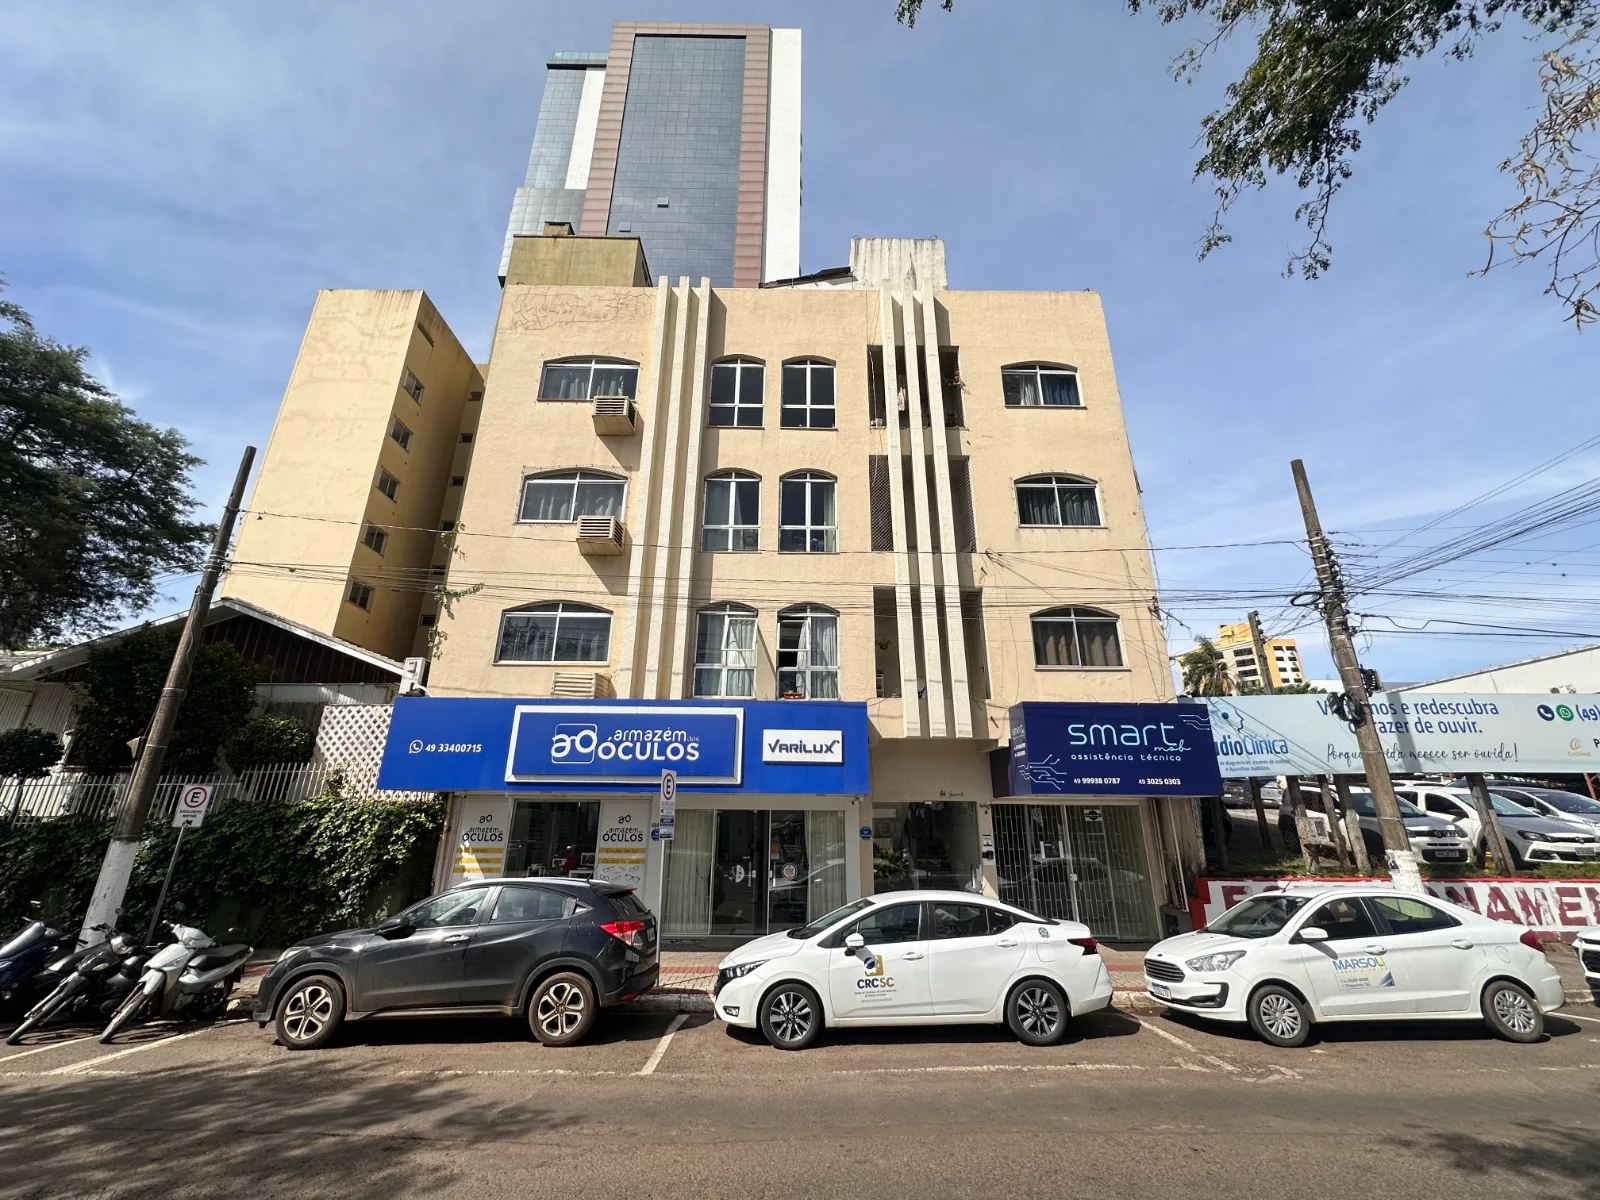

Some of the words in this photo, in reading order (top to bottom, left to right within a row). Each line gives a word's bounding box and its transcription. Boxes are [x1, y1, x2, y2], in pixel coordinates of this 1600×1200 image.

[1400, 703, 1410, 715] e
[1414, 698, 1499, 715] redescubra
[1374, 721, 1409, 734] azer
[1414, 716, 1434, 734] de
[1437, 717, 1483, 734] ouvir.
[613, 727, 687, 742] armazém
[1067, 722, 1178, 746] smart
[425, 743, 436, 752] 49
[438, 743, 482, 753] 33400715
[597, 736, 700, 761] ÓCULOS
[1154, 739, 1192, 752] mob
[1214, 734, 1289, 756] udioClínica
[1382, 742, 1406, 762] ida
[1452, 749, 1471, 761] ser
[1474, 741, 1518, 763] ouvida!
[1070, 752, 1134, 760] assistência
[1140, 753, 1182, 761] técnica
[666, 779, 672, 795] E
[190, 791, 202, 803] E
[602, 830, 643, 842] ÓCULOS
[856, 977, 895, 989] CRCSC
